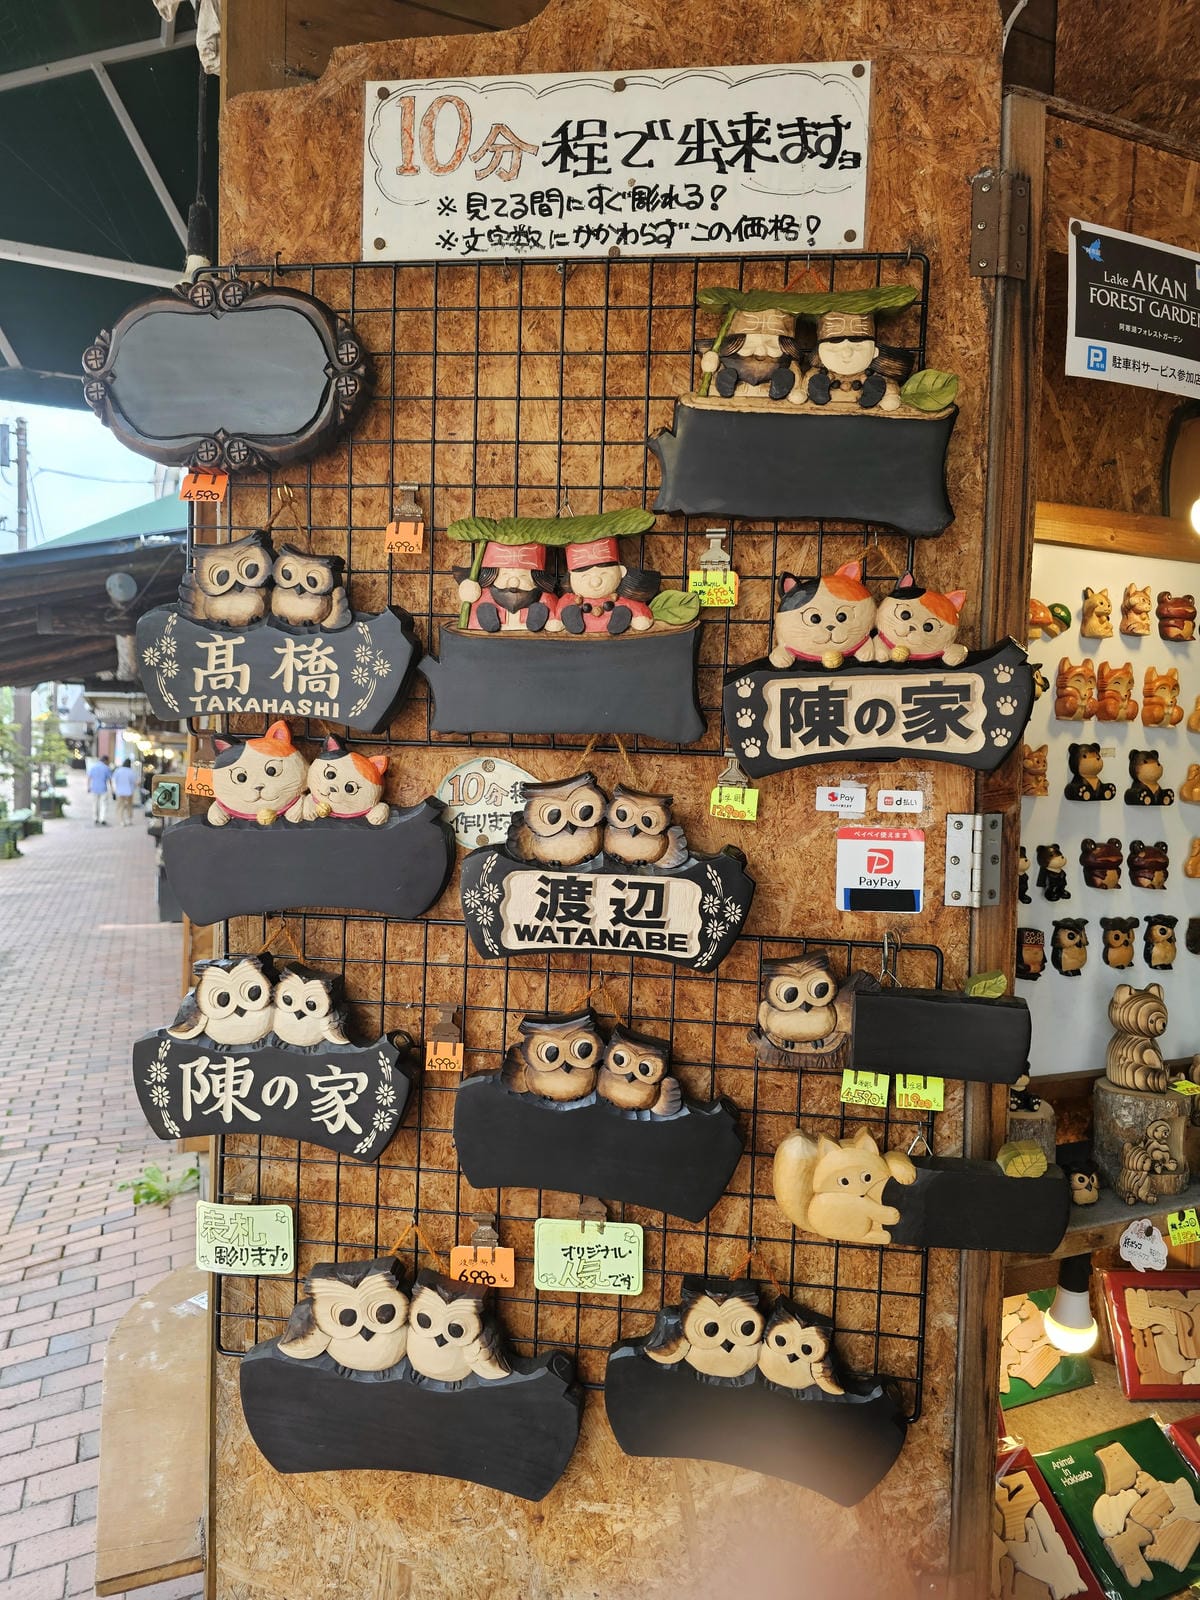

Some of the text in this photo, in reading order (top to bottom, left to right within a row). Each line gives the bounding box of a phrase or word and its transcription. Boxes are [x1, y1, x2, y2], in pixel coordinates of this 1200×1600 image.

[1104, 270, 1187, 302] Lake AKAN
[1089, 287, 1200, 327] FOREST GARDE
[184, 489, 220, 501] 4.590
[189, 696, 340, 718] TAKAHASHI
[779, 680, 974, 749] 陳の家
[840, 793, 855, 803] Pay
[853, 831, 908, 839] ペイペイ使えます
[859, 876, 901, 889] PayPay
[535, 874, 669, 930] 渡辺
[513, 922, 689, 953] WATANABE
[178, 1055, 369, 1135] 陳の家
[201, 1210, 267, 1247] 表札
[1051, 1455, 1075, 1470] Animal
[1060, 1470, 1093, 1487] Hokkaido
